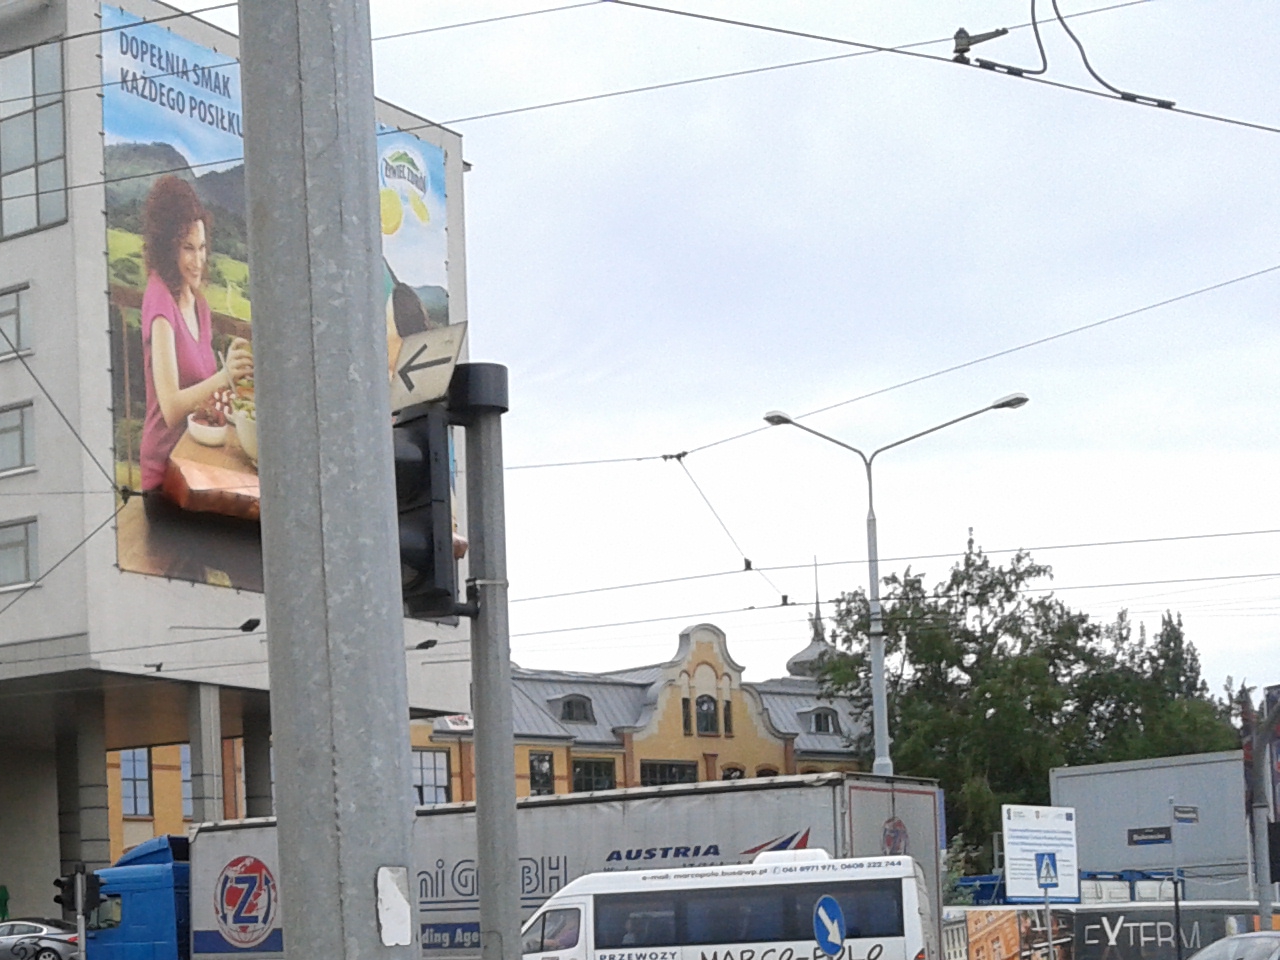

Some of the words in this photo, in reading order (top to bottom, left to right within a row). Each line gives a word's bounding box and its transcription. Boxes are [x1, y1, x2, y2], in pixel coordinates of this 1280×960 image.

[120, 31, 190, 82] DOPEŁNIA
[193, 63, 231, 99] SMAK
[120, 67, 186, 114] KAŻDEGO
[606, 844, 720, 862] AUSTRIA
[233, 876, 259, 924] Z
